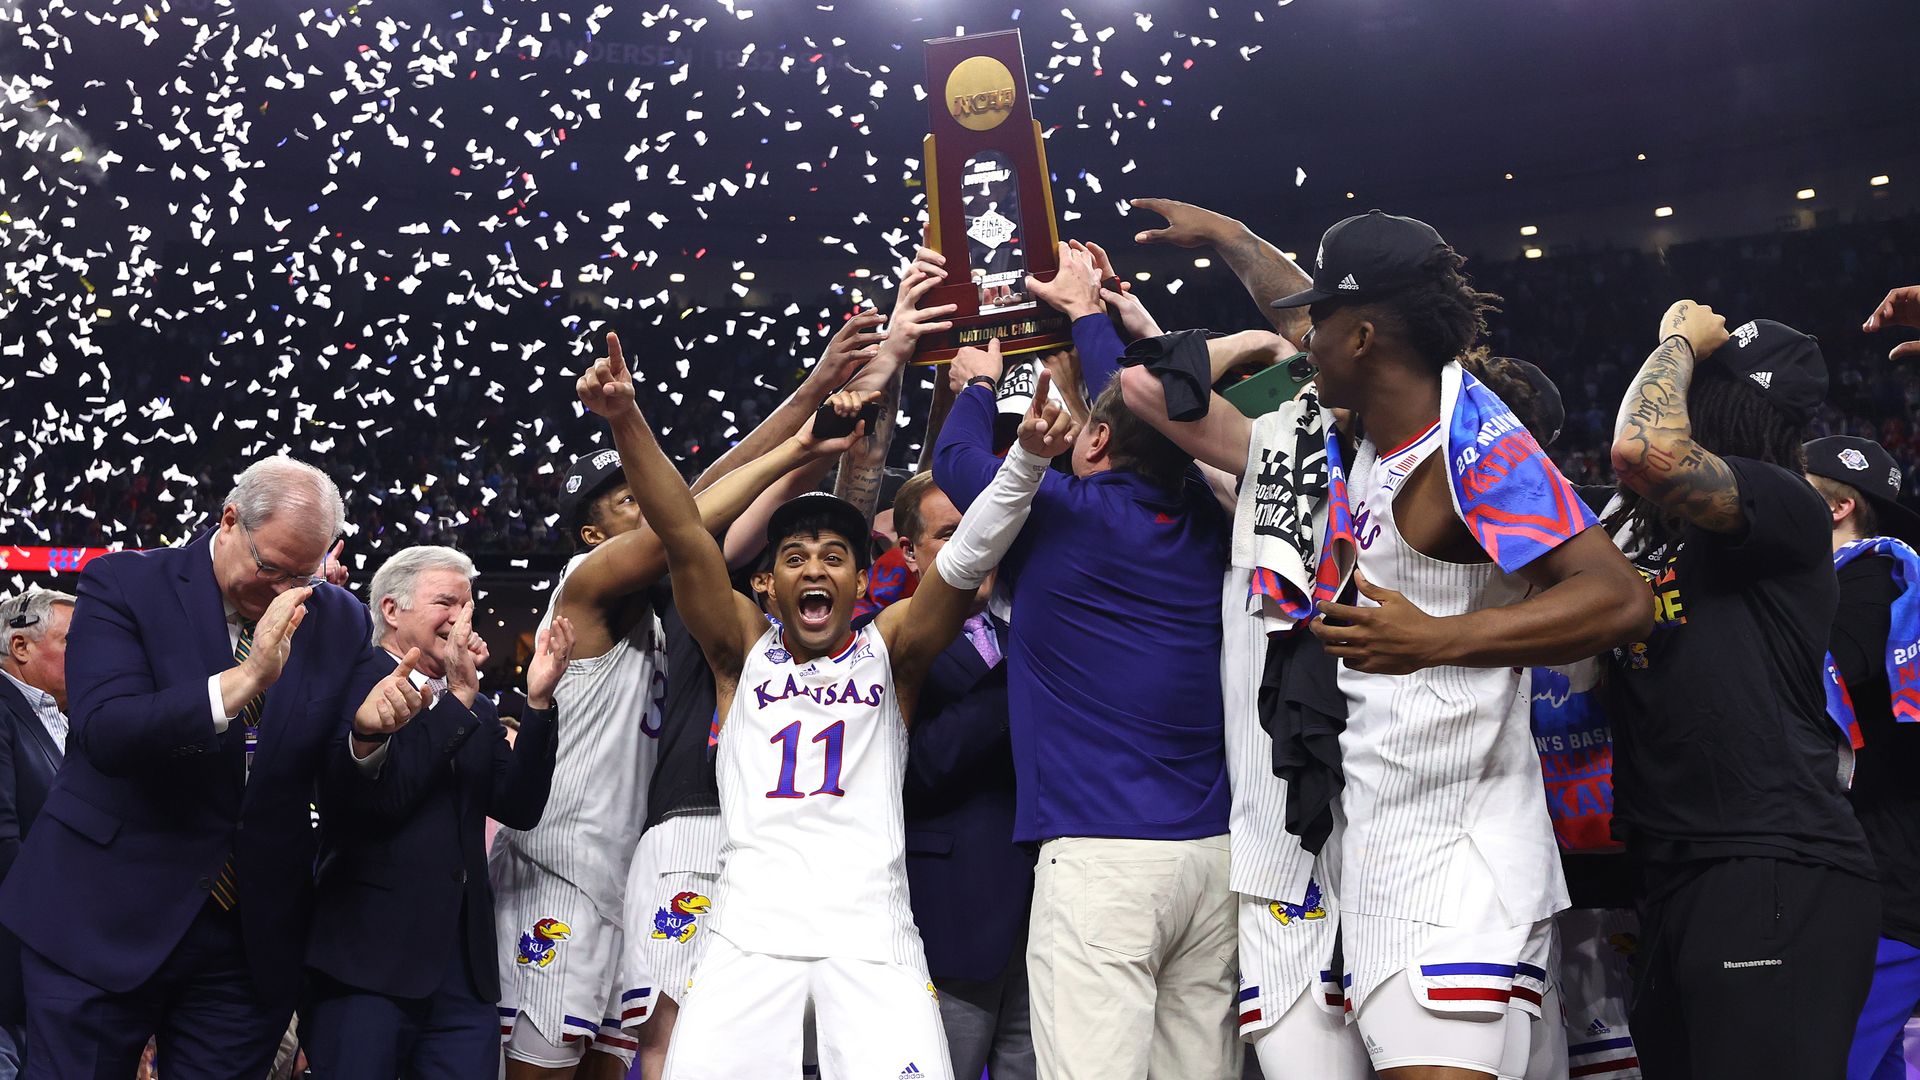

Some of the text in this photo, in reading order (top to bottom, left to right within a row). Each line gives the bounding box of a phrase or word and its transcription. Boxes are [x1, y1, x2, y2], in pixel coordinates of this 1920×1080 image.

[545, 38, 693, 67] ANDERSEN
[981, 219, 1003, 229] FINAL
[981, 227, 1003, 239] FOUR
[960, 325, 1009, 343] NATIONAL
[1631, 381, 1669, 426] City
[1647, 444, 1676, 472] 10
[753, 673, 884, 710] KANSAS
[765, 719, 845, 799] 11
[666, 917, 682, 929] KU
[529, 942, 543, 953] KU
[898, 1072, 925, 1080] adidas
